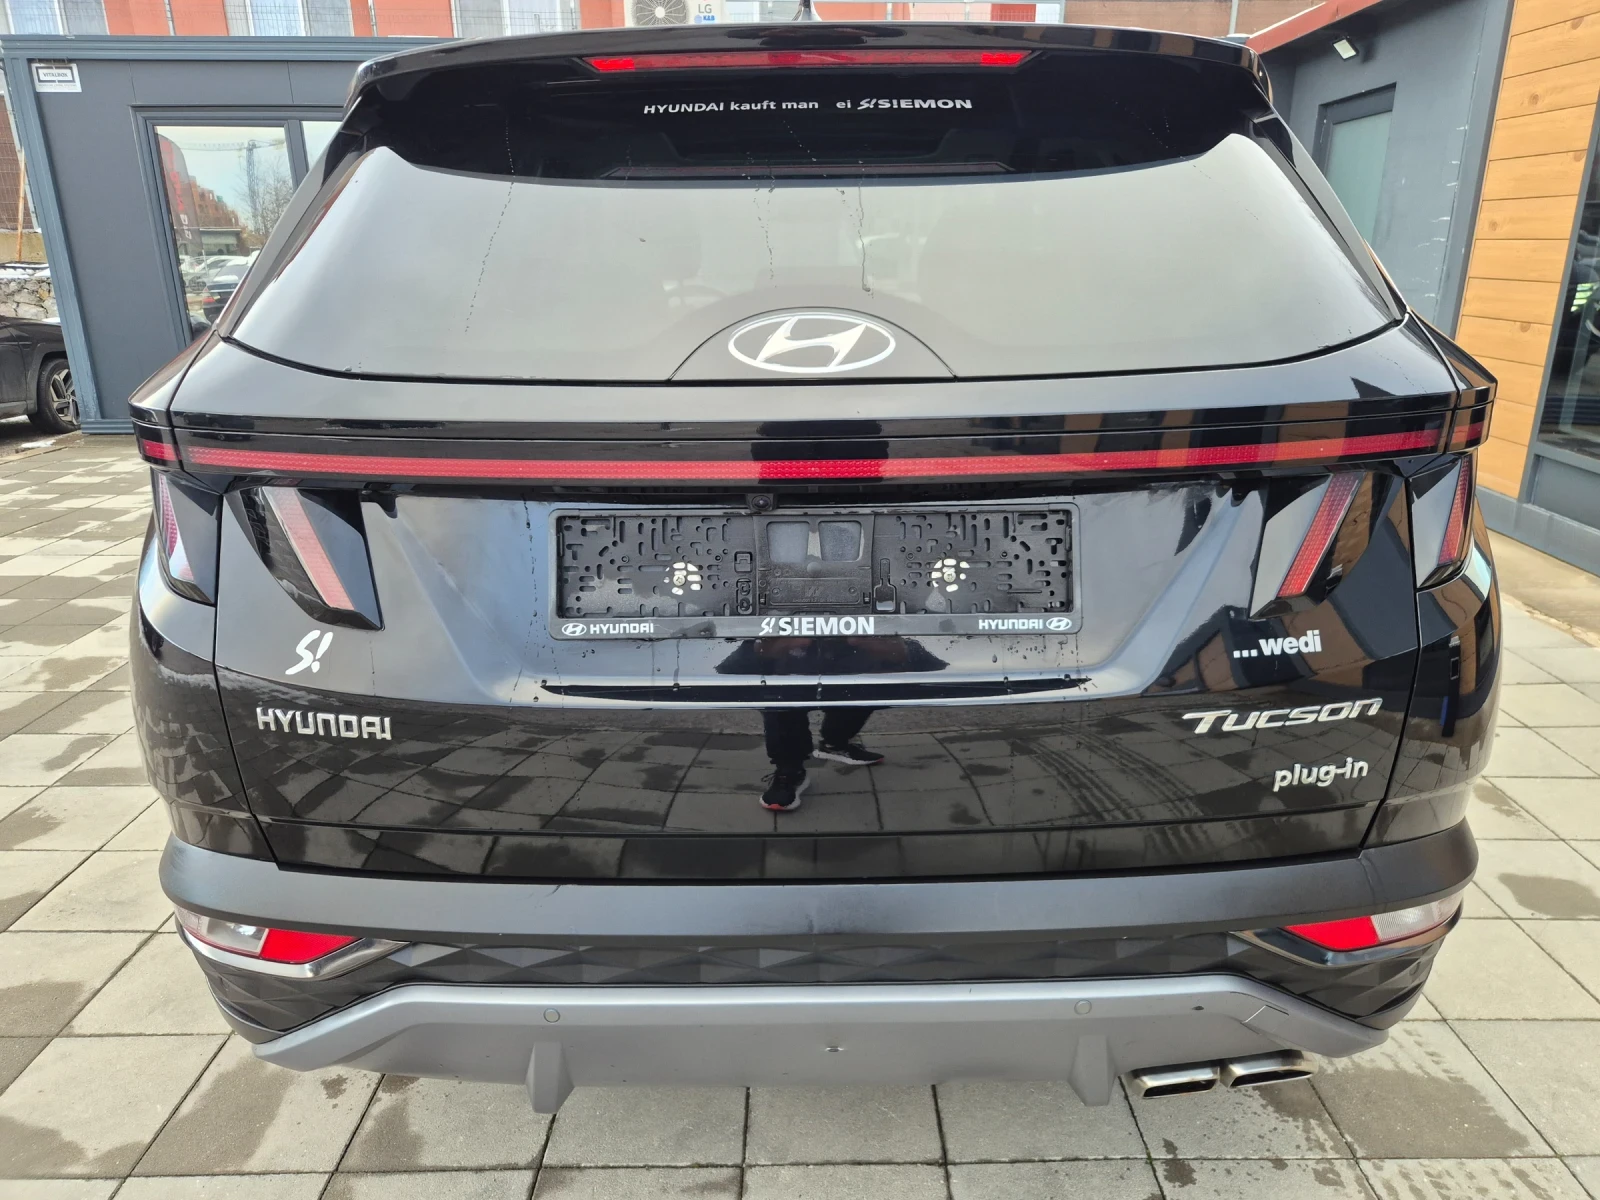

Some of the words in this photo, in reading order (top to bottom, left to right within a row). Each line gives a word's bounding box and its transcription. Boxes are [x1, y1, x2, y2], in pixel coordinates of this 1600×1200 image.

[698, 4, 712, 13] LG
[643, 102, 724, 114] HYUNDAI
[730, 100, 777, 111] kauft
[781, 101, 819, 109] man
[589, 623, 654, 634] HYUNDAI
[978, 619, 1044, 630] HYUNDAI
[255, 706, 392, 740] HYUNDAI
[1272, 757, 1369, 792] plug-in
